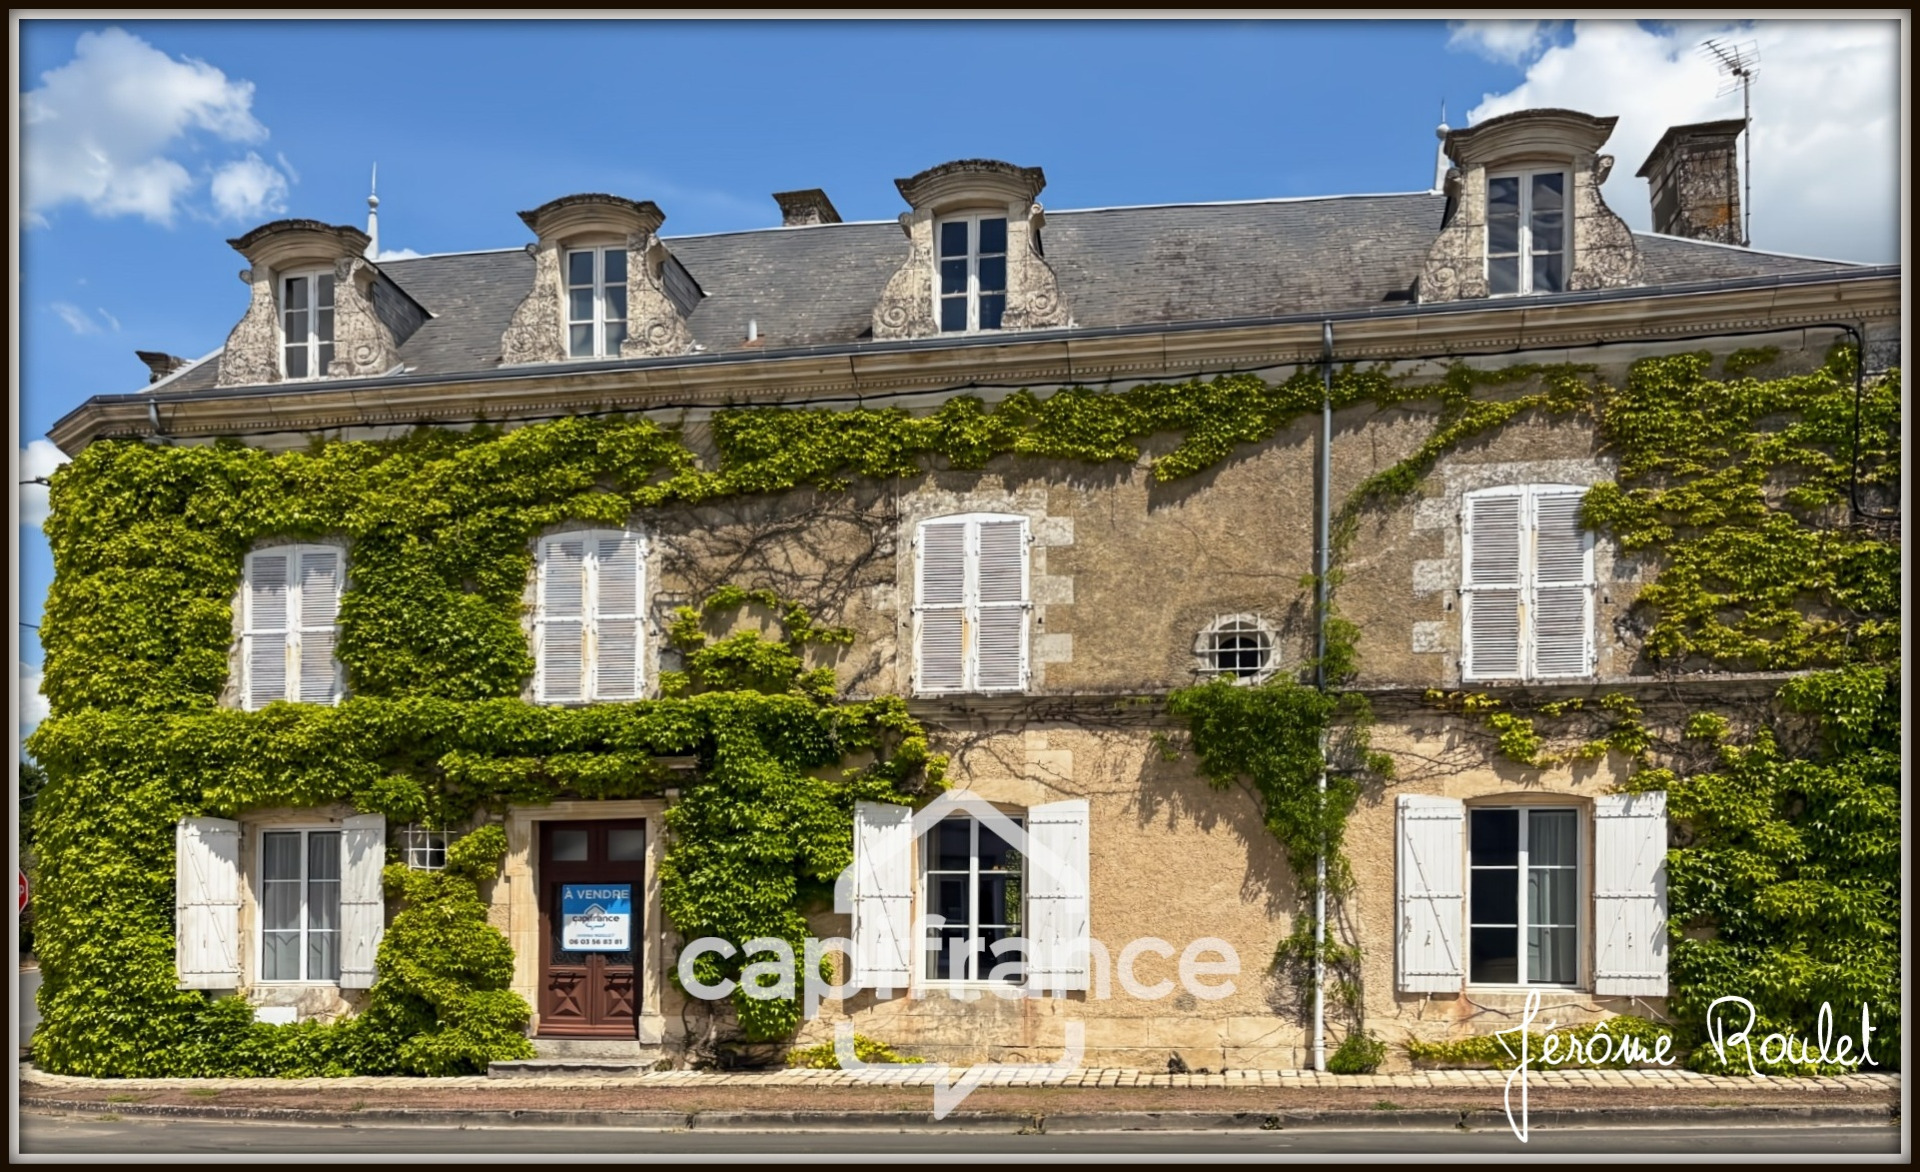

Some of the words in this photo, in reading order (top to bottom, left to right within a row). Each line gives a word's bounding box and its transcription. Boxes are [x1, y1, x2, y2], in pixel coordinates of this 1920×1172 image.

[564, 887, 574, 899] À
[577, 889, 630, 899] VENDRE
[572, 913, 620, 924] capifrance
